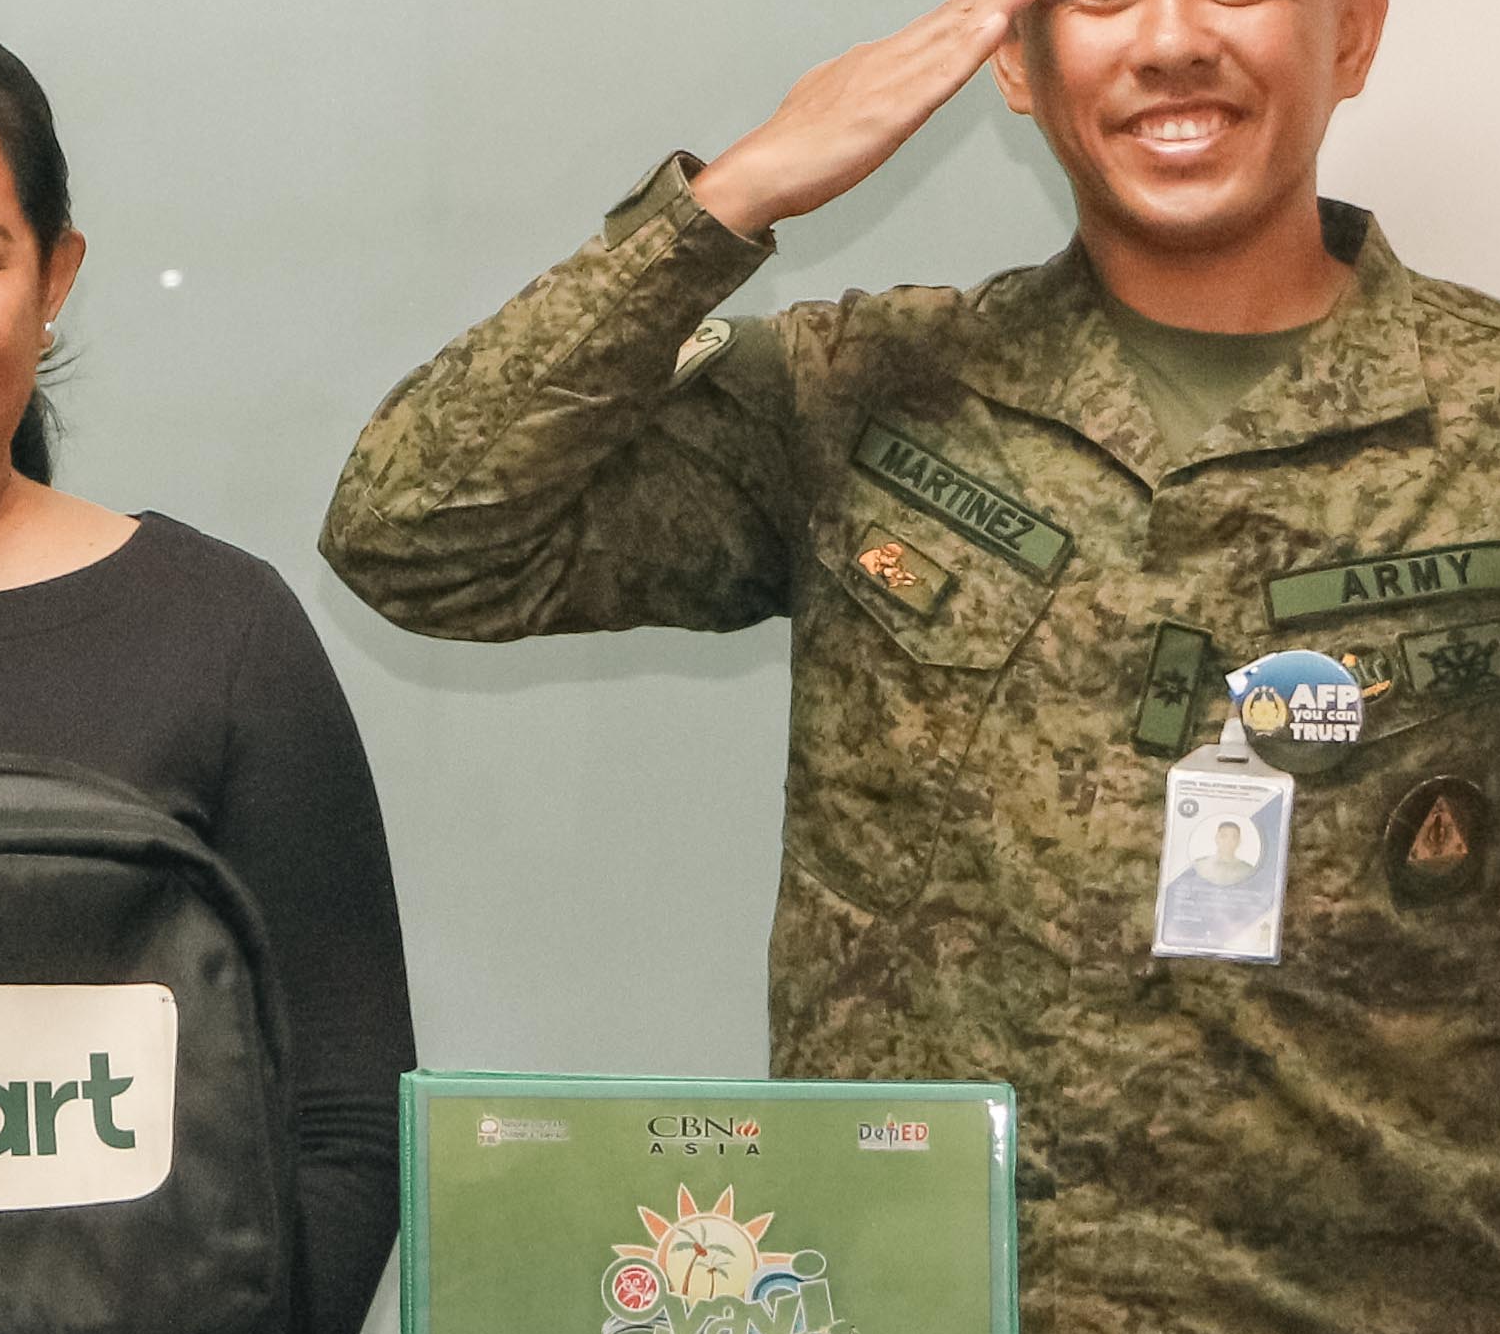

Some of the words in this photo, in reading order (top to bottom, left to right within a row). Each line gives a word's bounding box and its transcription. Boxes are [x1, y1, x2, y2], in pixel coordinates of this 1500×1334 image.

[878, 441, 1036, 552] MARTINEZ
[1341, 551, 1472, 604] ARMY
[1288, 683, 1361, 710] AFP
[1292, 709, 1323, 723] you
[1326, 709, 1357, 722] can
[1289, 722, 1361, 742] TRUST
[647, 1116, 734, 1139] CBN
[649, 1142, 761, 1156] ASIA
